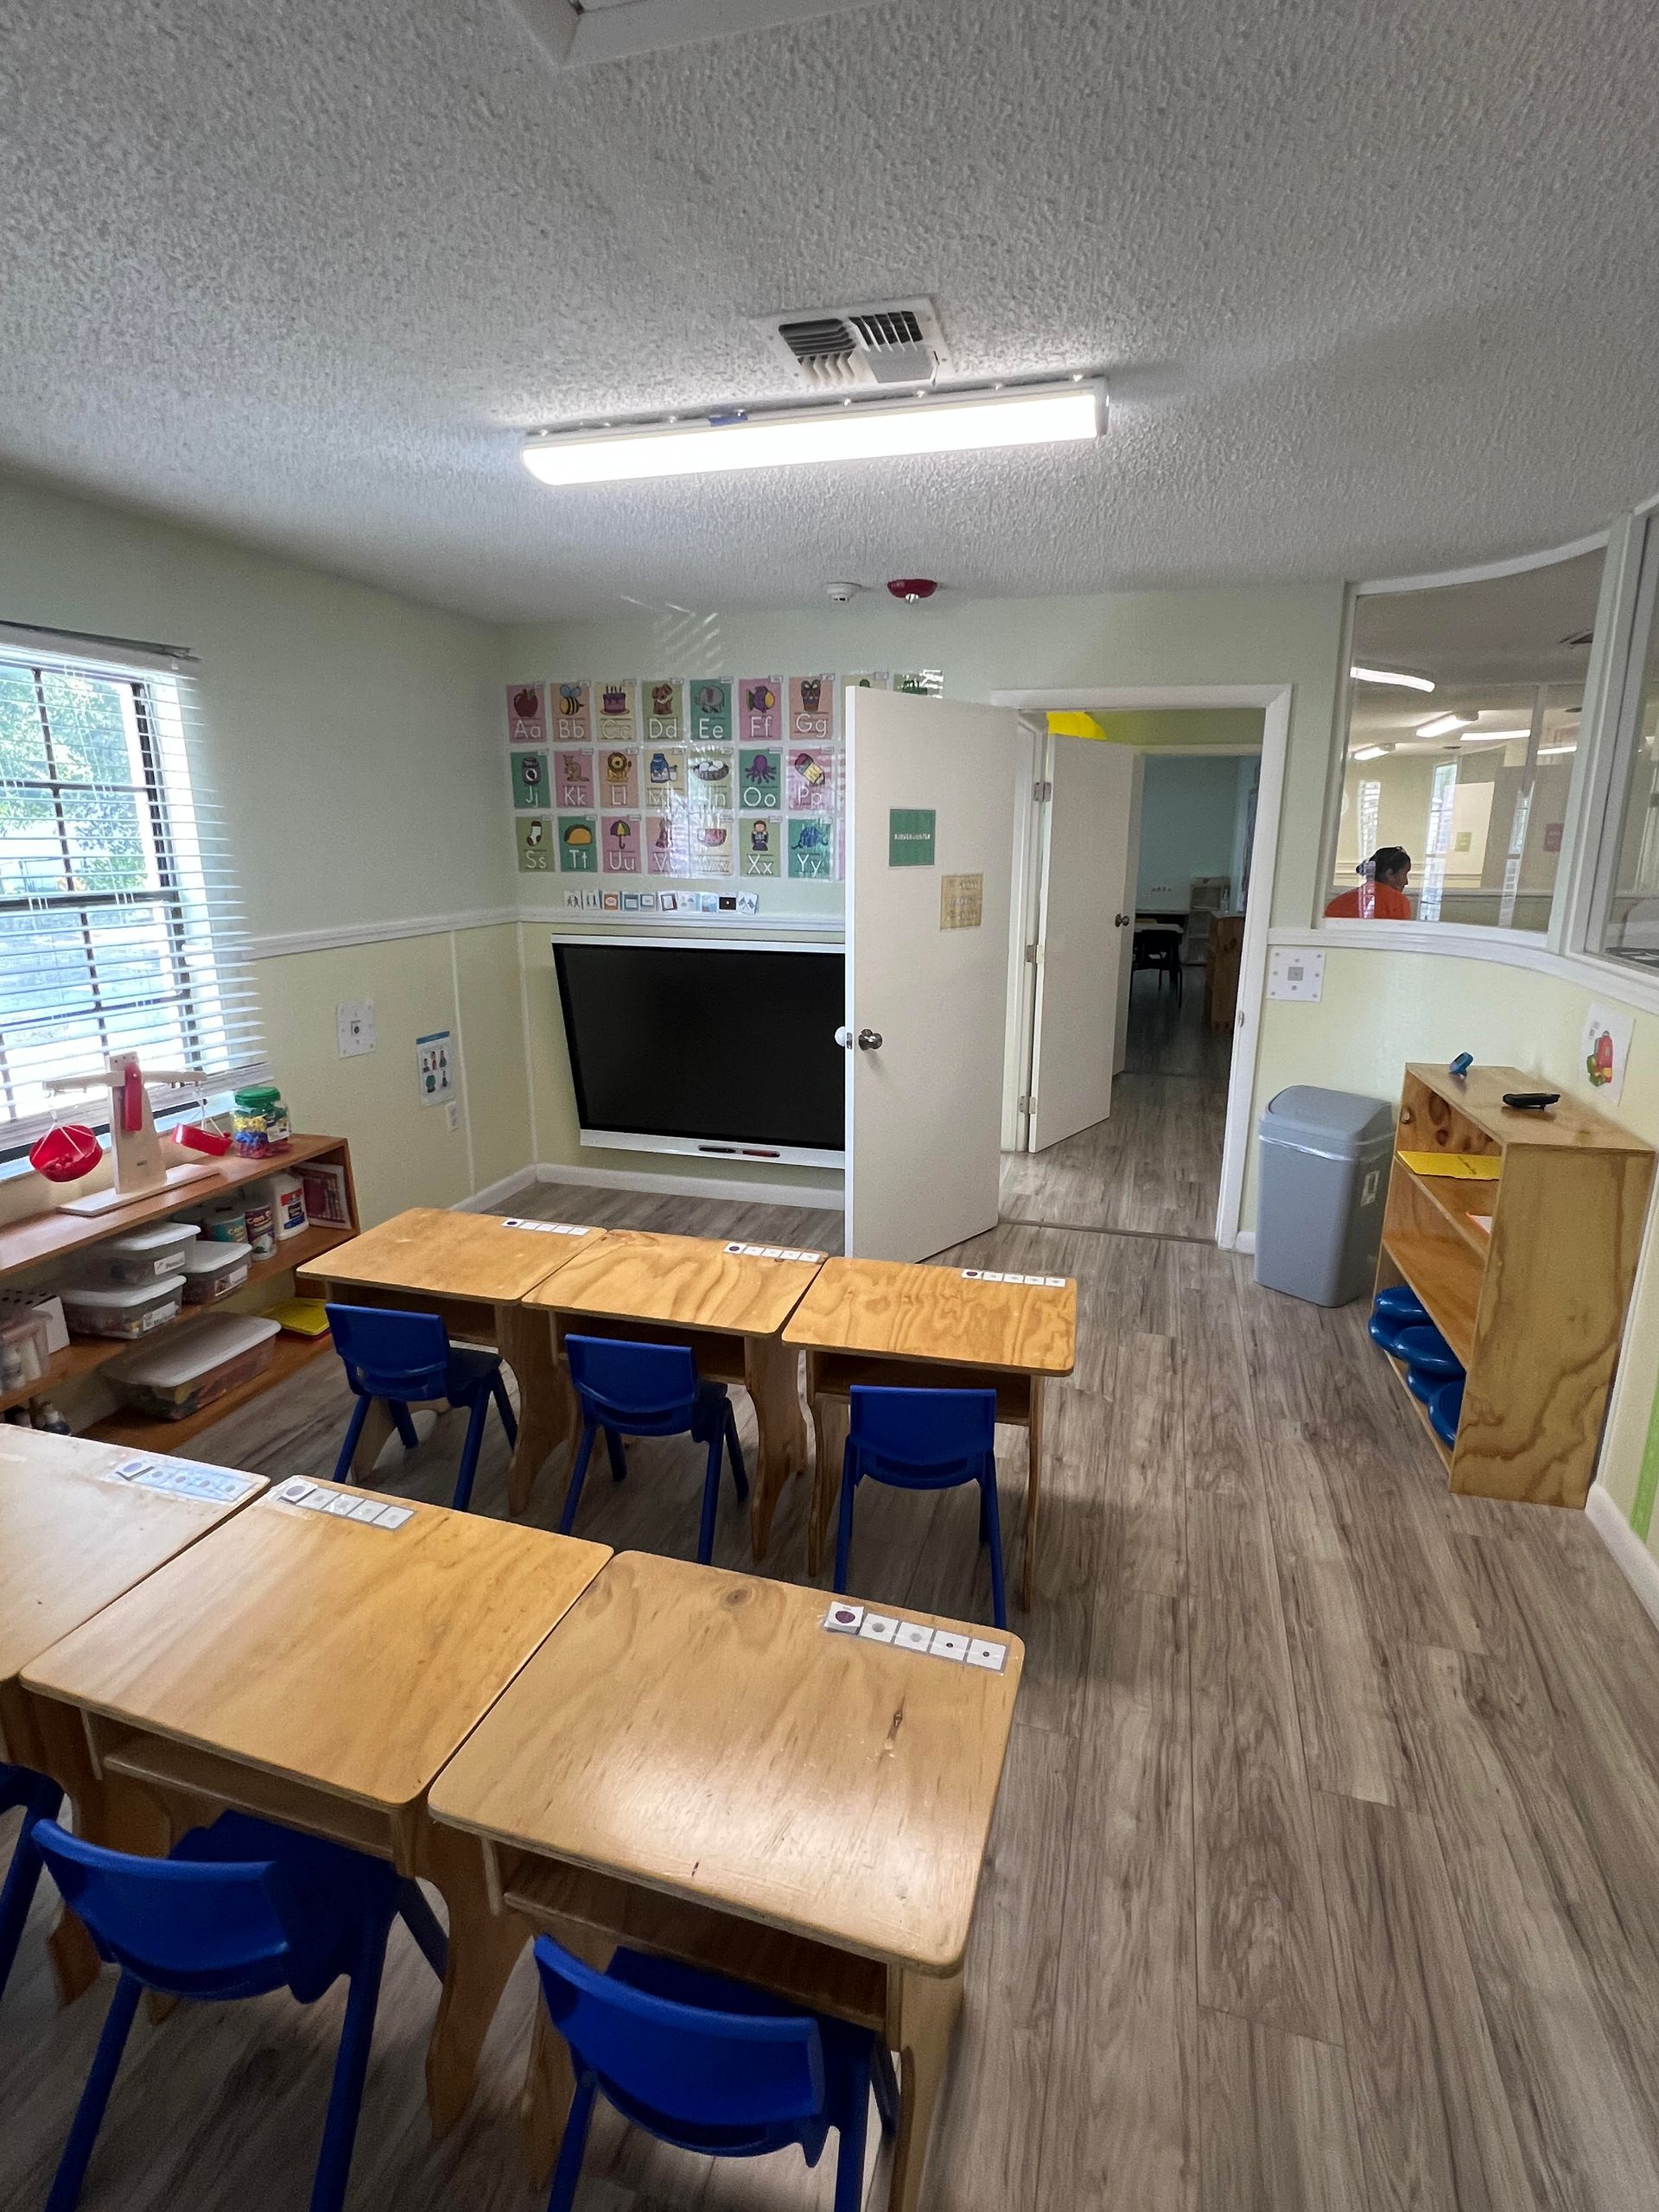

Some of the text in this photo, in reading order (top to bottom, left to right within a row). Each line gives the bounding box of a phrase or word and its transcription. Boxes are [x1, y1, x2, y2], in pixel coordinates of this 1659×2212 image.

[514, 720, 542, 739] Aa
[558, 719, 586, 739] Bb
[602, 720, 631, 740] Cc
[649, 718, 677, 738] Dd
[698, 718, 724, 739] Ee
[751, 716, 772, 737] Ff
[796, 713, 827, 738] Gg
[525, 785, 538, 808] Jj
[564, 786, 587, 805] Kk
[612, 785, 626, 805] Ll
[743, 786, 776, 807] Oo
[798, 785, 822, 809] Pp
[525, 850, 547, 868] Ss
[569, 849, 588, 868] Tt
[609, 850, 635, 870] Uu
[748, 855, 772, 874] Xx
[797, 854, 821, 877] Yy
